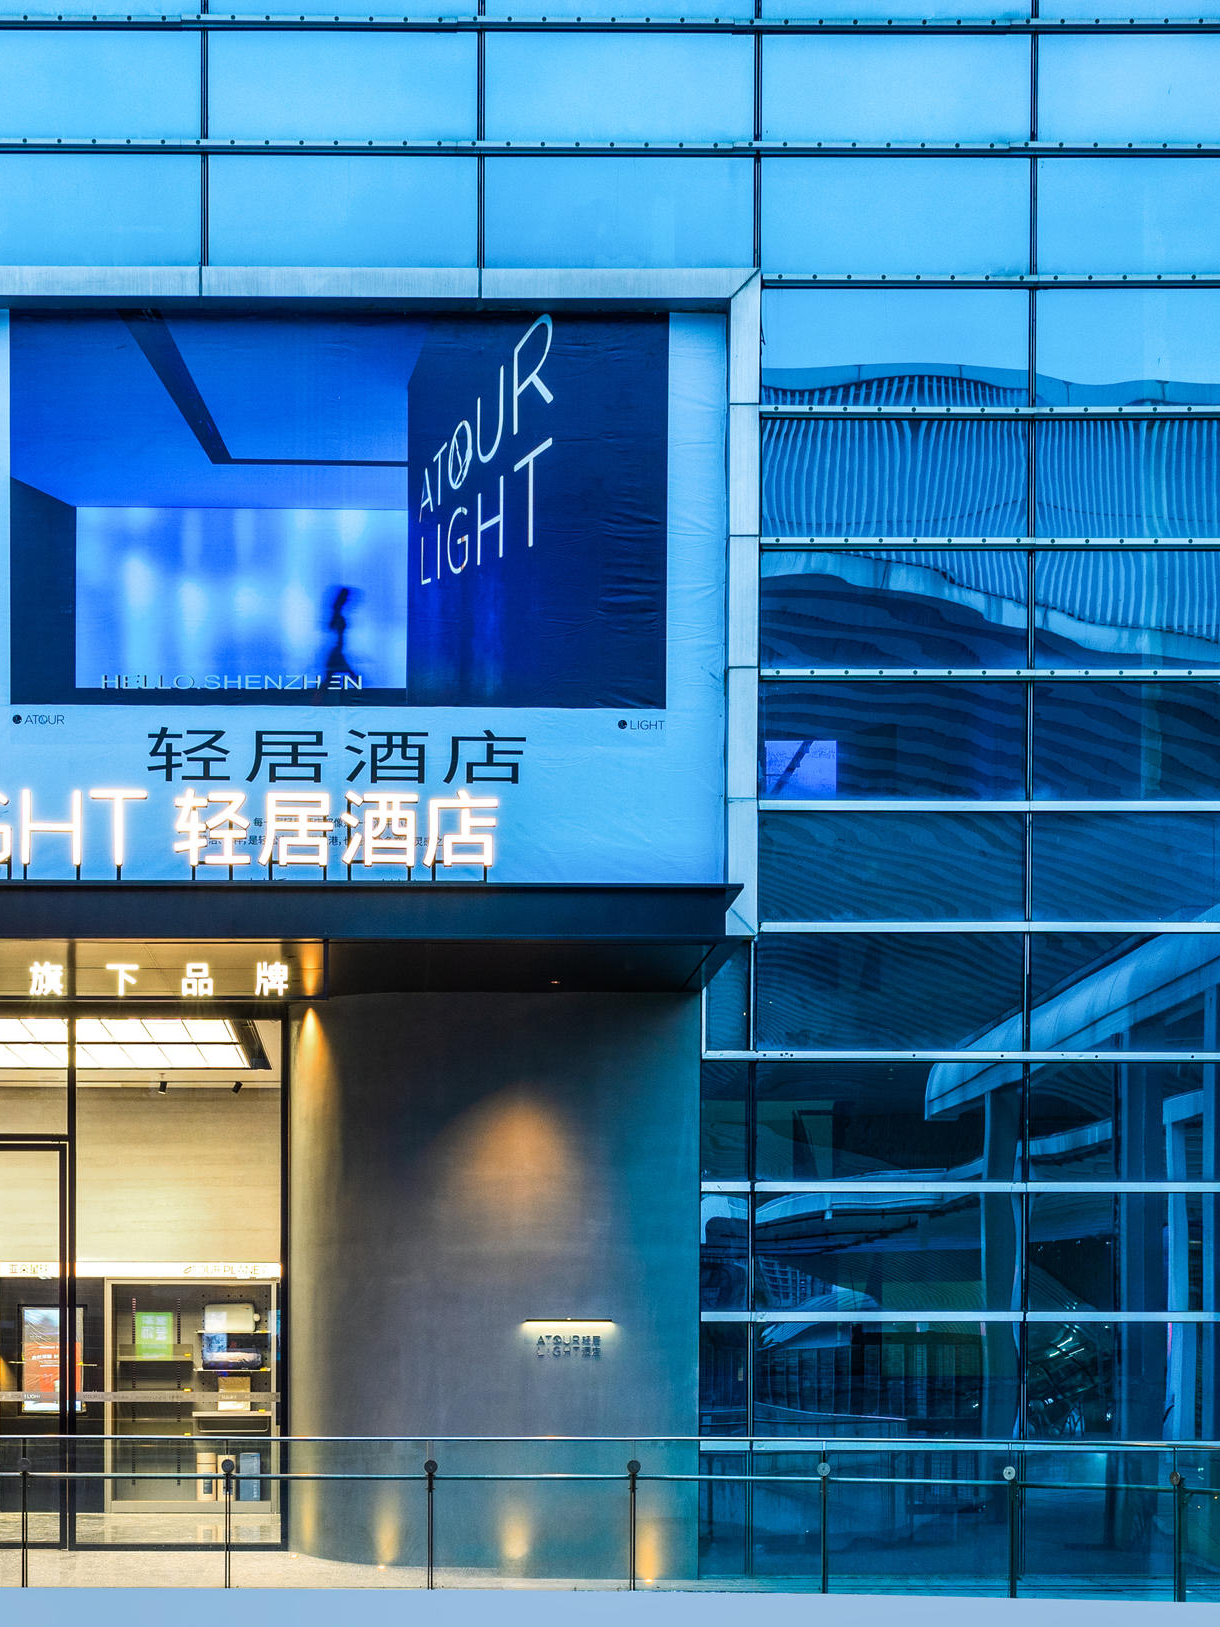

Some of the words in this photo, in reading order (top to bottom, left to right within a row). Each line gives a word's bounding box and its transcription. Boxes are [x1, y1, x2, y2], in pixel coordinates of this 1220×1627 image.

[418, 313, 554, 523] ATOUR
[420, 437, 553, 586] LIGHT
[24, 714, 65, 725] ATOUR
[629, 719, 665, 731] LIGHT
[146, 727, 527, 785] 轻居酒店
[173, 788, 500, 868] 轻居酒店
